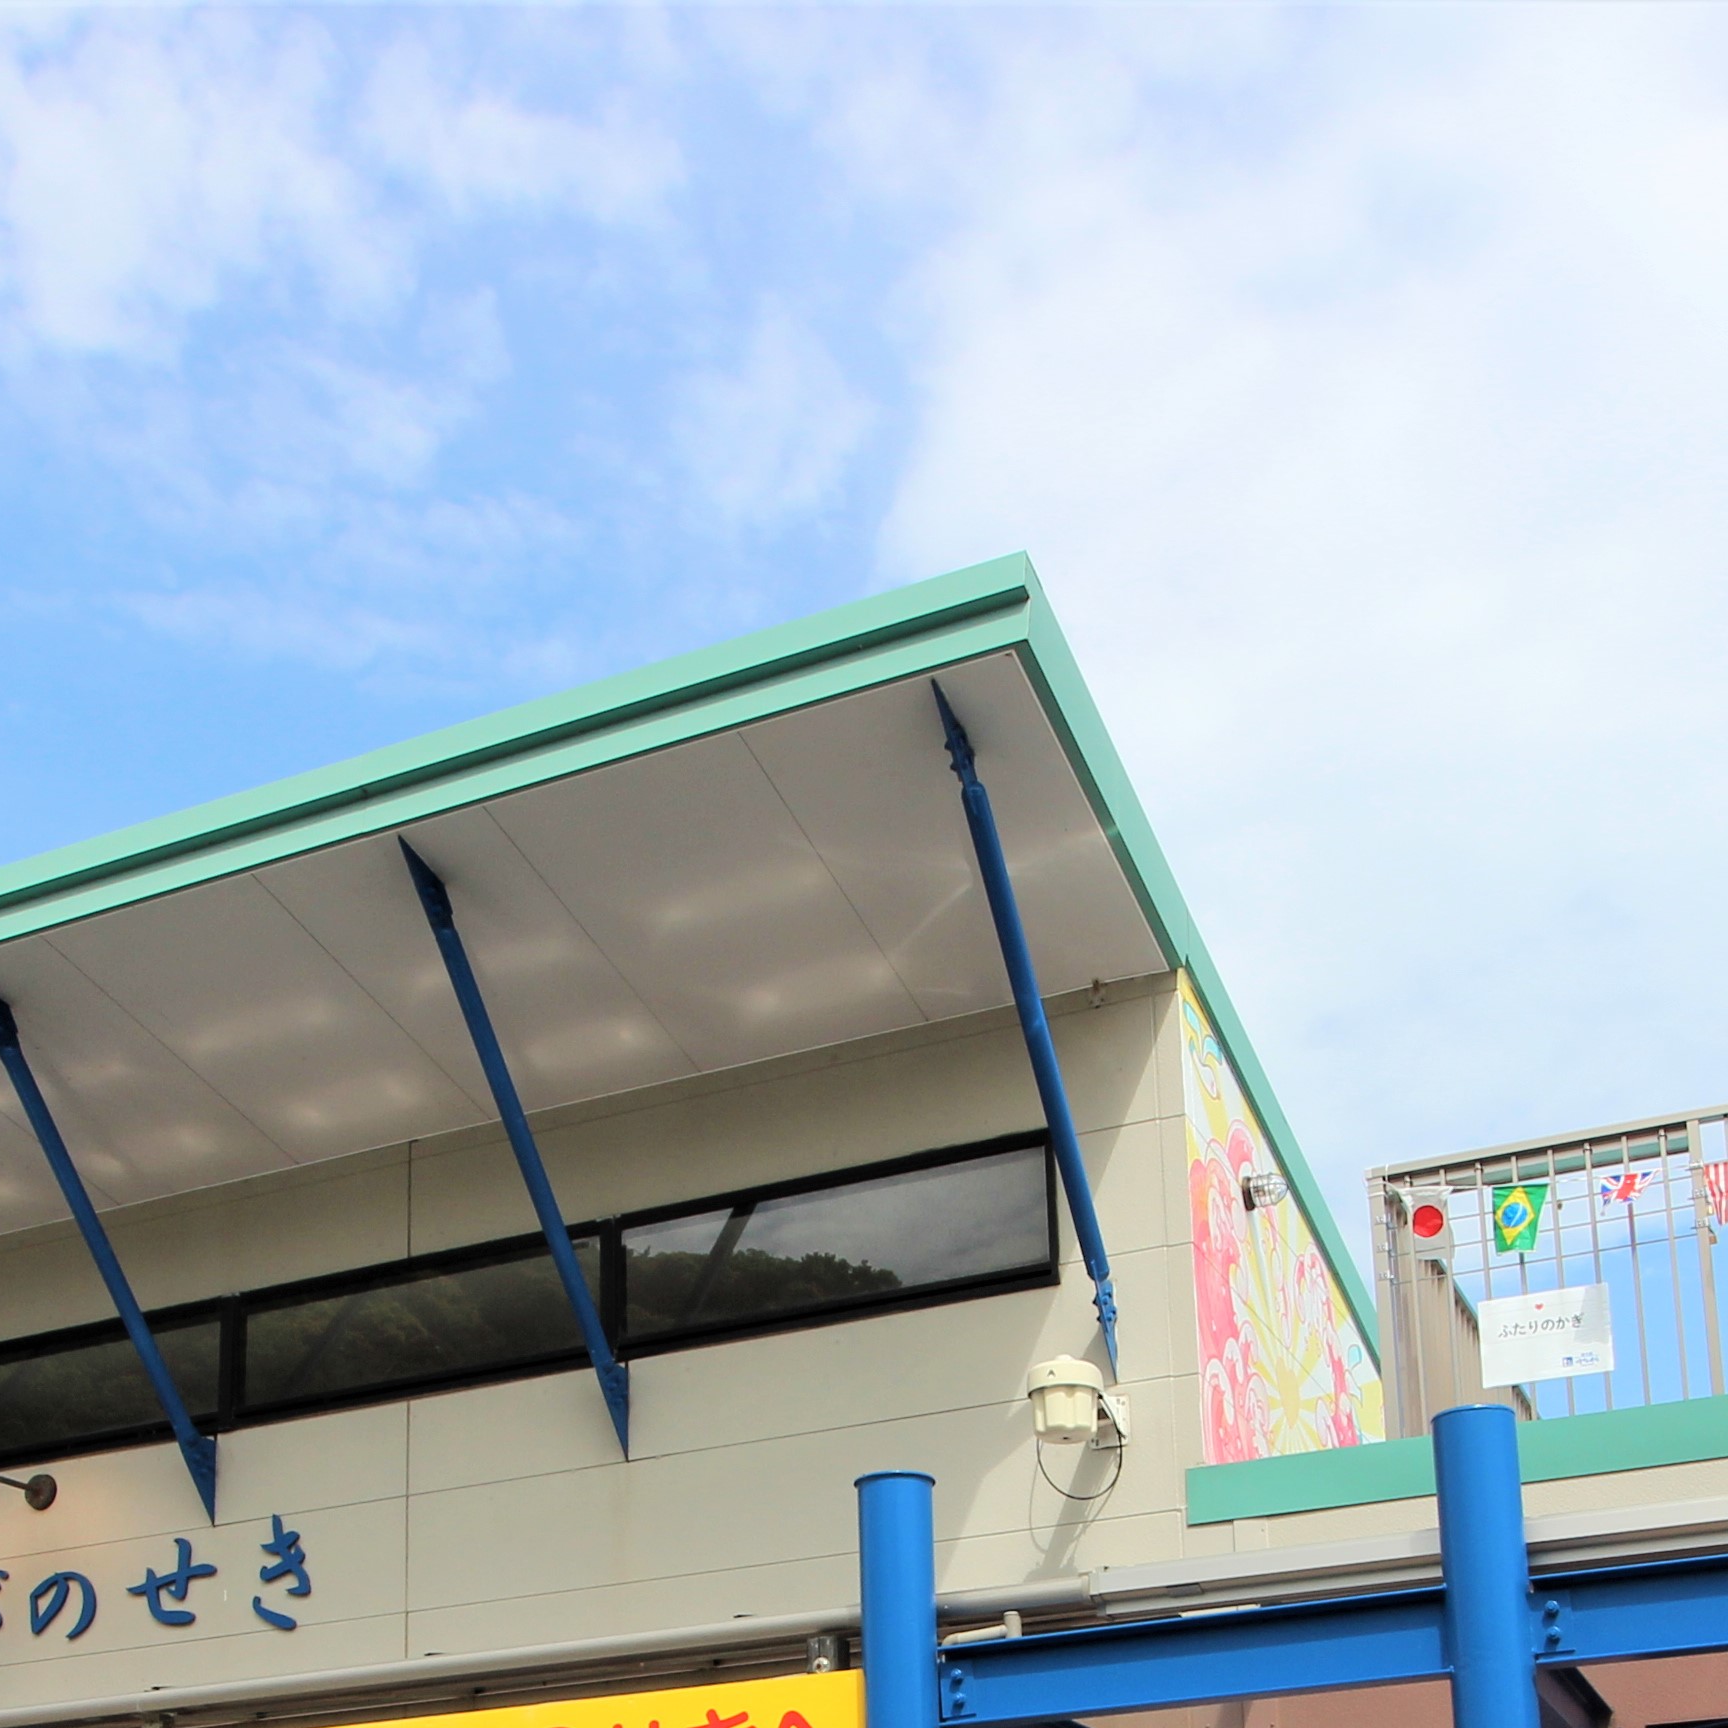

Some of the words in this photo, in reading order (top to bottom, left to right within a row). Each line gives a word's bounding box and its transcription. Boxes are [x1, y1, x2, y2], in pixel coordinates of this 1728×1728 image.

[1498, 1312, 1584, 1338] ふたりのかぎ
